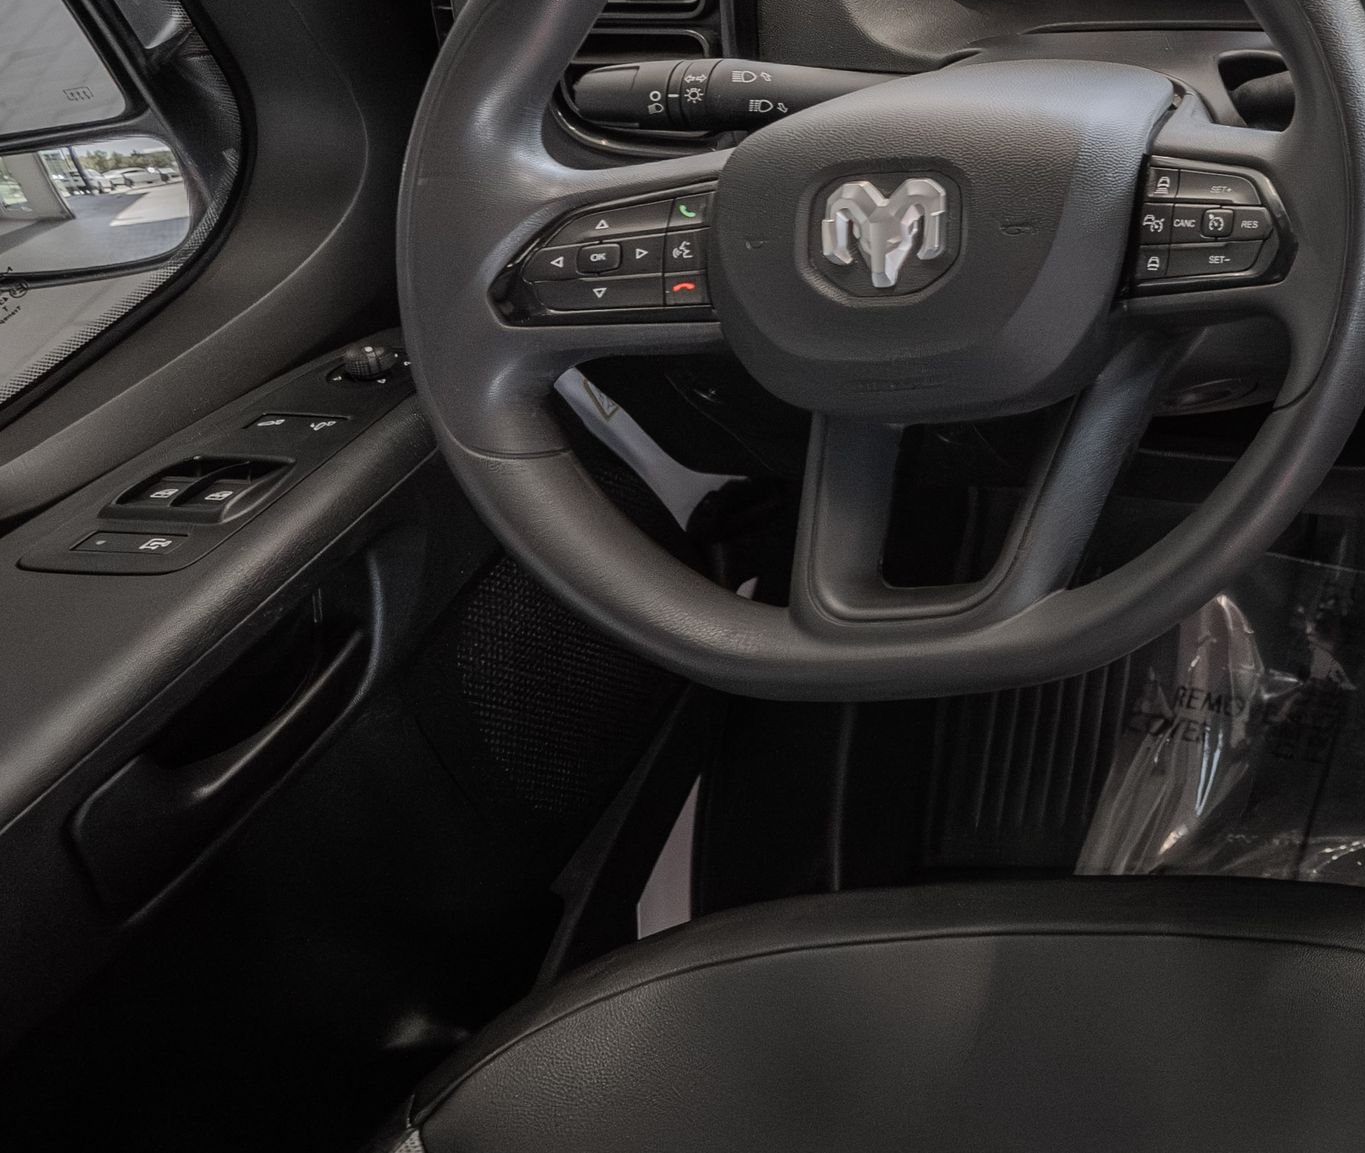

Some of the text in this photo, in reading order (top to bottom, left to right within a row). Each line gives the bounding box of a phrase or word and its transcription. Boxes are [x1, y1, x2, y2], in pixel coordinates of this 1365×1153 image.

[1174, 219, 1196, 228] CANC
[1240, 220, 1258, 228] RES
[590, 252, 607, 262] OK
